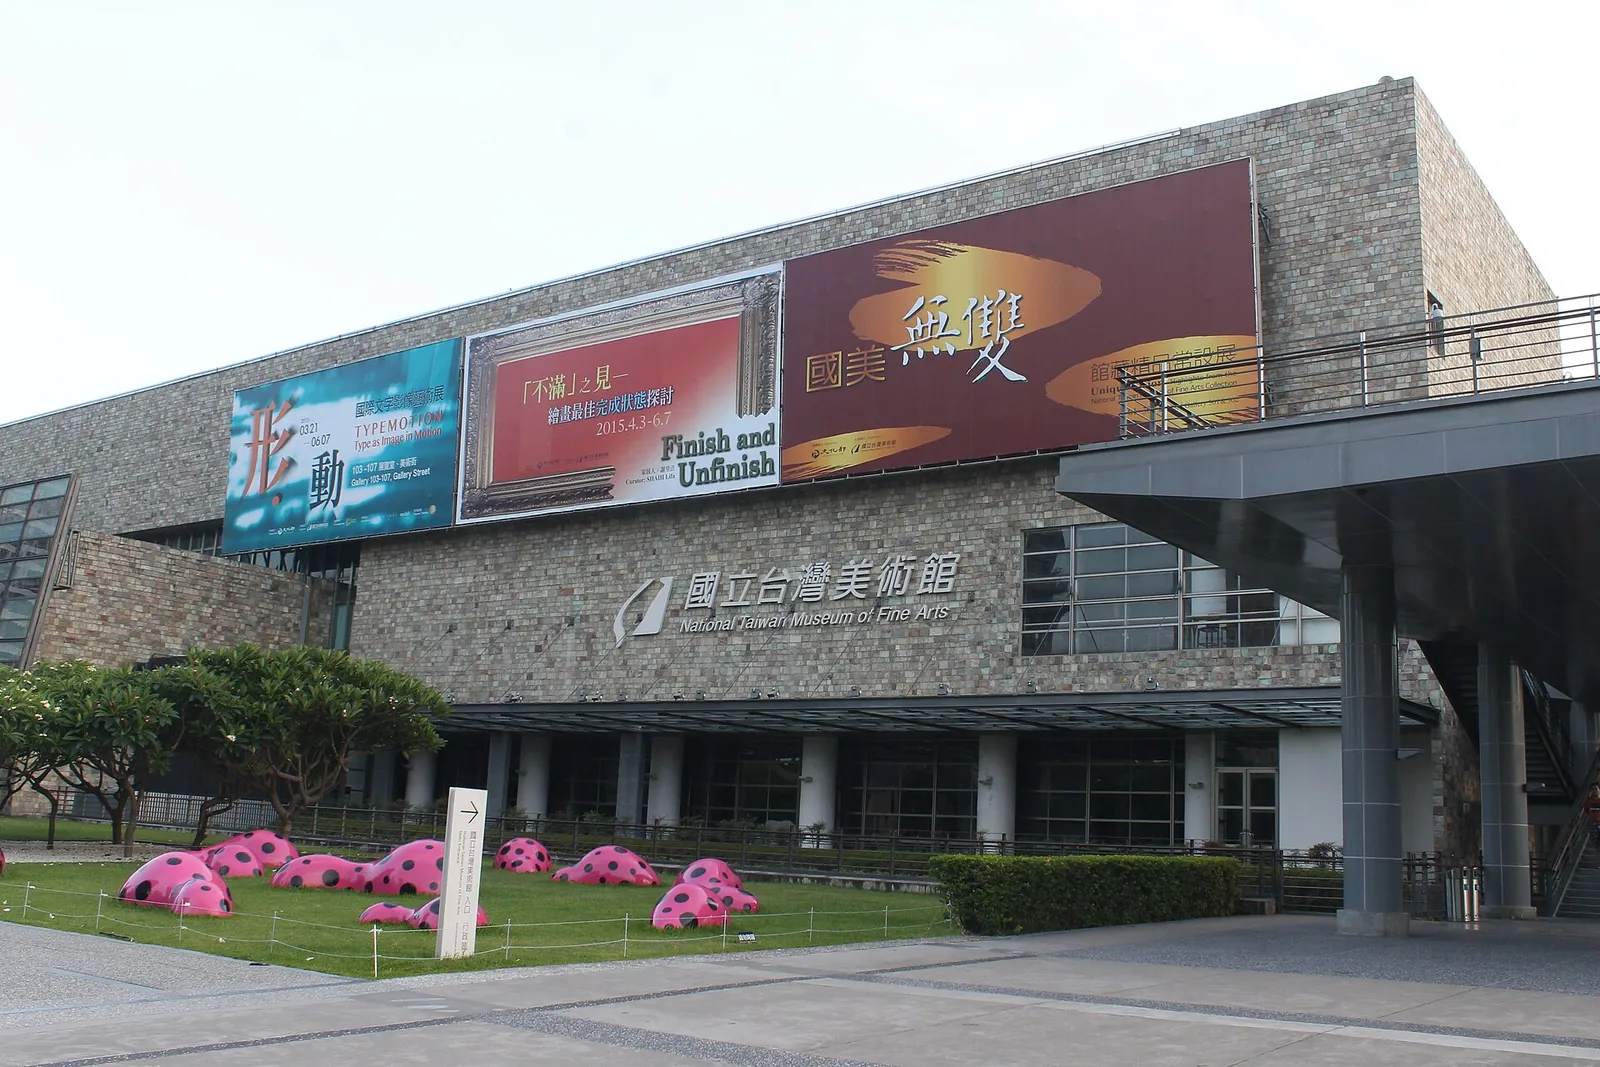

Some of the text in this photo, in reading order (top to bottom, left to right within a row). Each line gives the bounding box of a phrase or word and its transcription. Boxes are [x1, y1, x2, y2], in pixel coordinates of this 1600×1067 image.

[806, 289, 1029, 393] 國美 無雙
[1206, 380, 1238, 388] Collection
[356, 385, 444, 419] 國際文字影像藝術展
[547, 386, 674, 425] 繪畫最佳完成狀態探討
[355, 410, 444, 438] TYPEMOTION
[355, 426, 442, 452] Type as Image in Motion
[596, 411, 672, 436] 2015.4.3-6.7
[242, 399, 294, 498] 形
[661, 423, 775, 461] Finish and
[309, 450, 345, 511] 動
[351, 477, 369, 487] Gallery
[393, 470, 412, 480] Gallery
[413, 467, 431, 477] Street
[678, 451, 775, 488] Unfinish
[684, 552, 961, 610] 國立台灣美術館
[680, 604, 949, 633] National Taiwan Museum of Fine Arts
[464, 896, 471, 914] 入口
